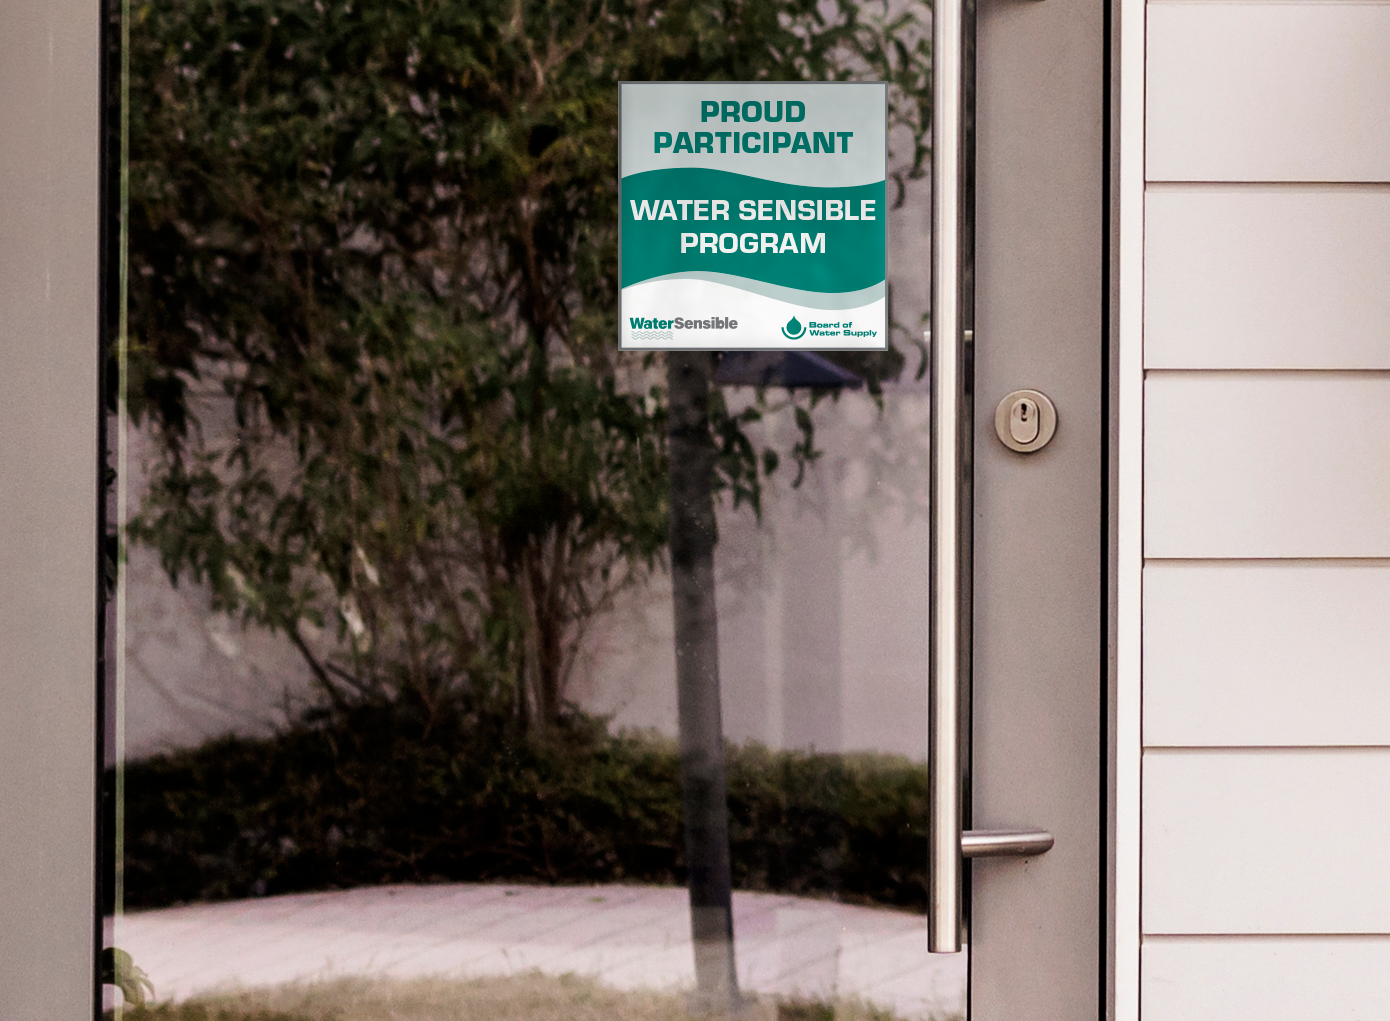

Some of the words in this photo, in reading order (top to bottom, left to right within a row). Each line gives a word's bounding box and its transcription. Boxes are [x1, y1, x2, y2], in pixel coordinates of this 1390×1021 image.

[701, 100, 806, 123] PROUD
[653, 131, 854, 154] PARTICIPANT
[629, 199, 730, 221] WATER
[738, 199, 877, 221] SENSIBLE
[680, 232, 826, 254] PROGRAM
[629, 316, 739, 330] WaterSensible
[808, 321, 840, 329] Board
[842, 321, 853, 329] of
[809, 329, 841, 337] Water
[843, 329, 878, 338] Supply
